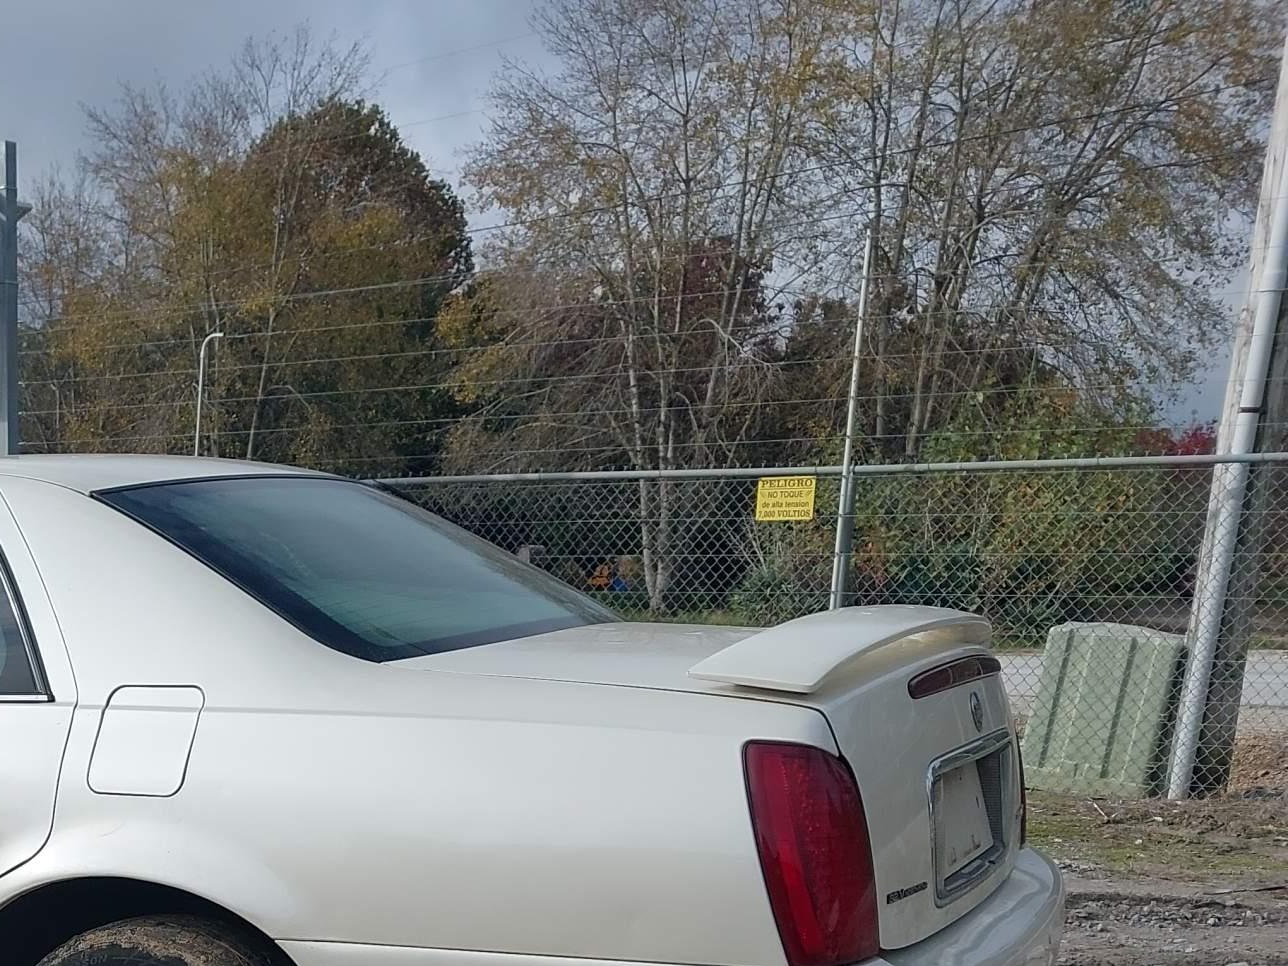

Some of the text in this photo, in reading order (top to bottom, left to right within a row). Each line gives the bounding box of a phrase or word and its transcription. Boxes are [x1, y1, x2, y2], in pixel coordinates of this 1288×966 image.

[761, 479, 813, 488] PELIGRO
[780, 490, 804, 498] TOQUE
[777, 509, 810, 518] VOLTIOS
